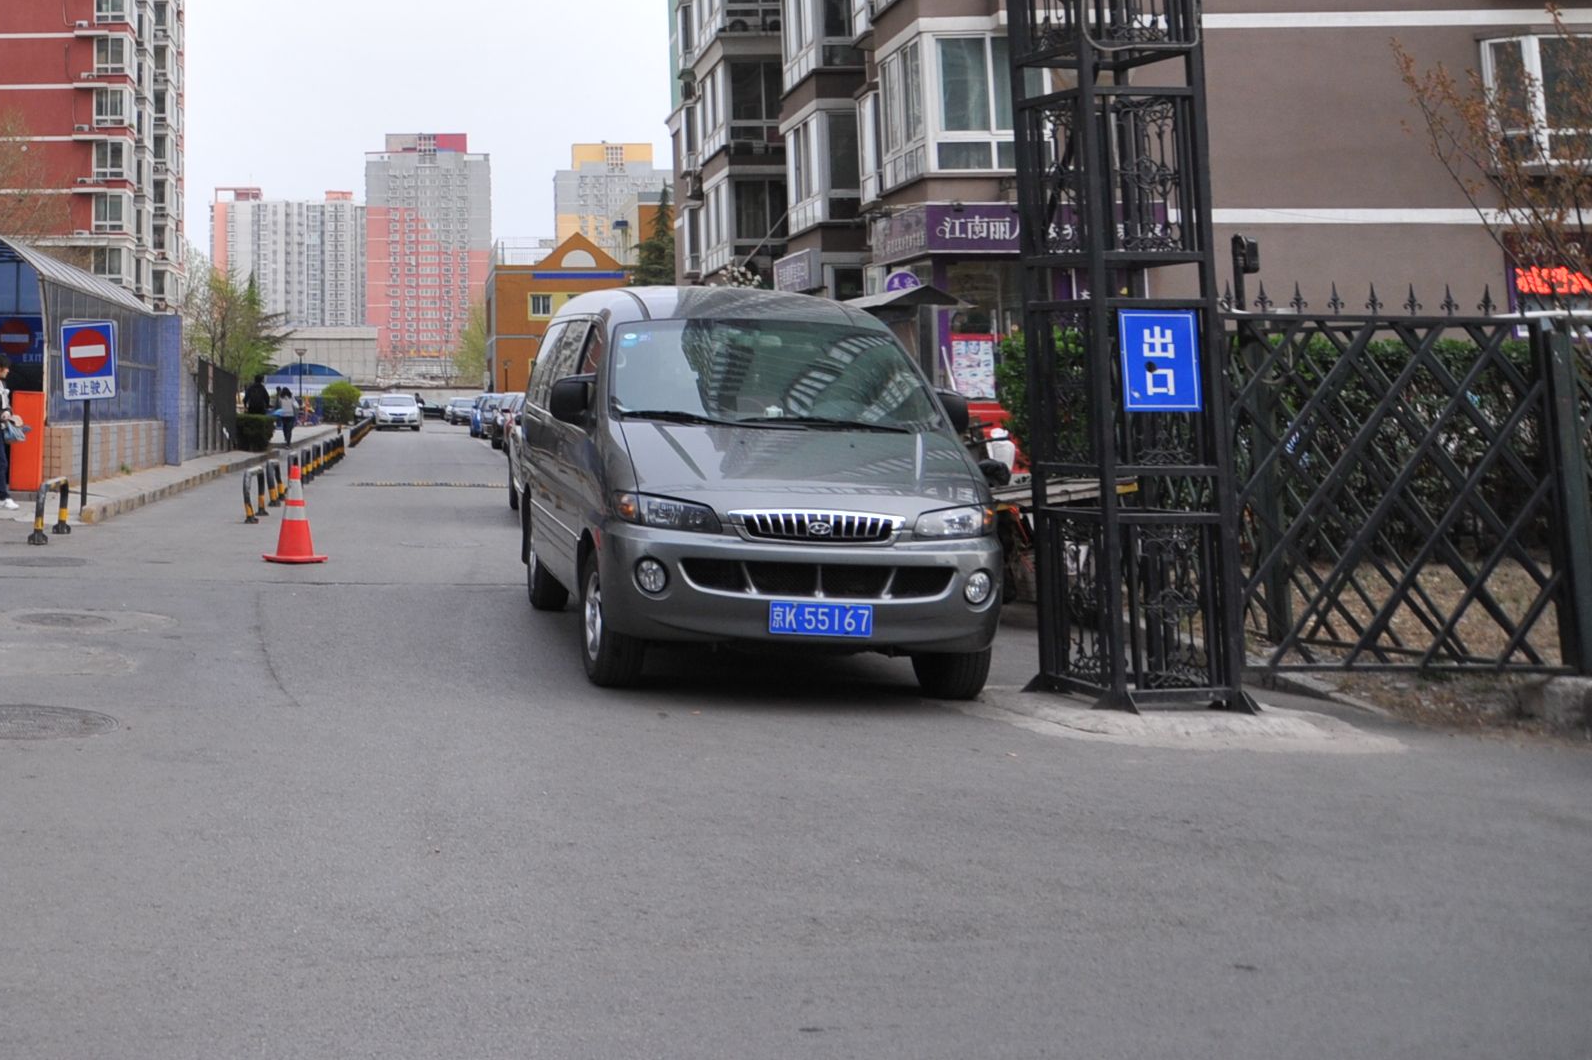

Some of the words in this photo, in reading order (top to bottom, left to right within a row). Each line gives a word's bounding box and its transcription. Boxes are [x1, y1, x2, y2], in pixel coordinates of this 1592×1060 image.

[22, 353, 43, 363] EXIT
[1142, 325, 1176, 396] 出口
[68, 380, 113, 397] 禁止驶入
